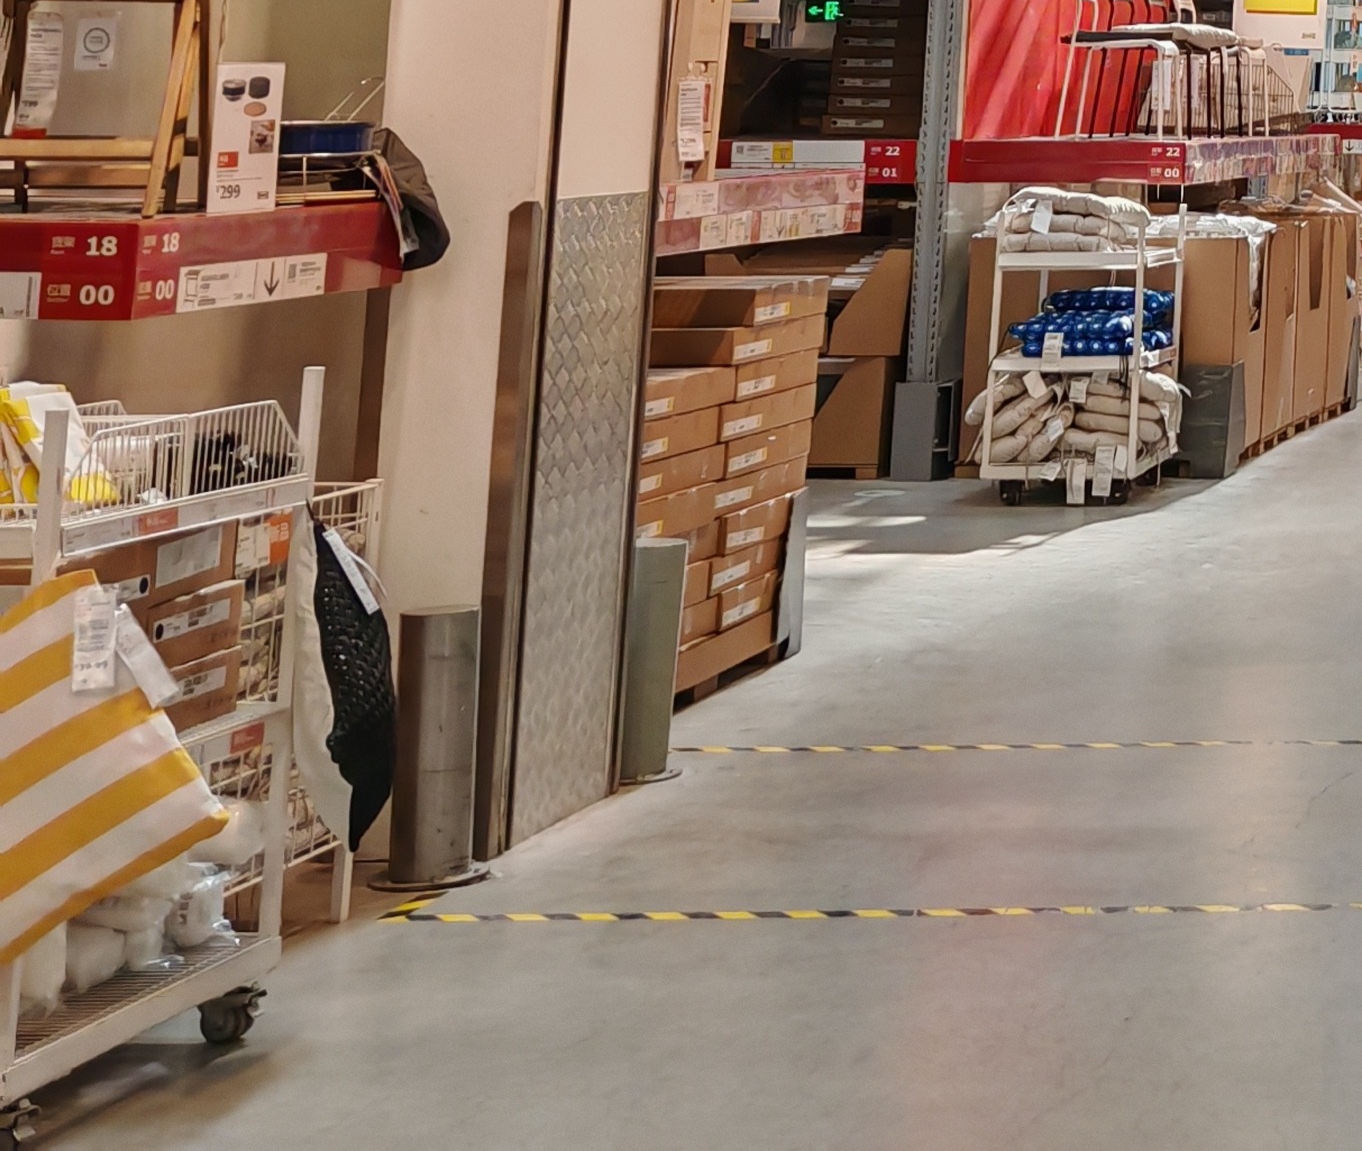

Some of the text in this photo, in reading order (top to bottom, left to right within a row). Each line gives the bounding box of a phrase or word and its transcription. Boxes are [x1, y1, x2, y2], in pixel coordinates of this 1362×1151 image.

[885, 146, 900, 156] 22
[1165, 147, 1181, 157] 22
[882, 167, 898, 177] 01
[1164, 167, 1181, 178] 00
[215, 183, 241, 200] ¥299
[85, 235, 119, 256] 18
[161, 231, 181, 252] 18
[79, 284, 116, 305] 00
[154, 279, 175, 301] 00
